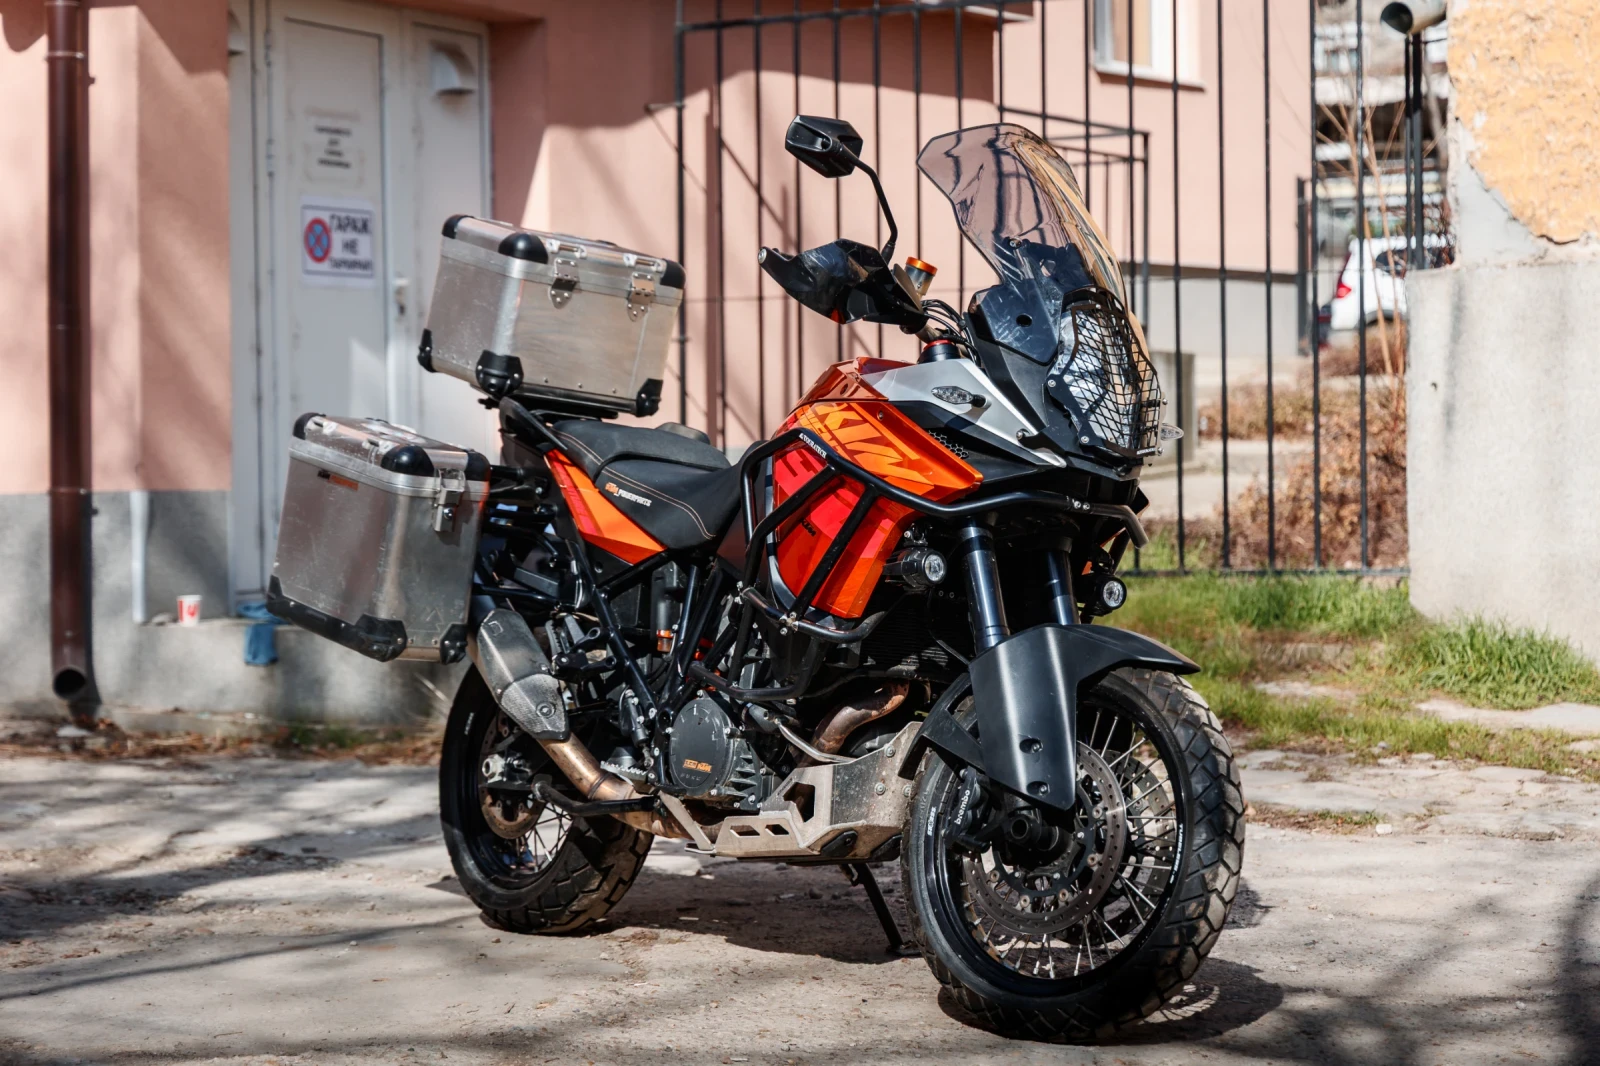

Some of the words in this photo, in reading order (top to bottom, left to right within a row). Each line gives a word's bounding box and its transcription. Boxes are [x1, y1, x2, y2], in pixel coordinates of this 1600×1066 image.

[330, 214, 371, 235] ГАРАЖ
[341, 238, 358, 255] НЕ
[953, 789, 971, 825] brembo
